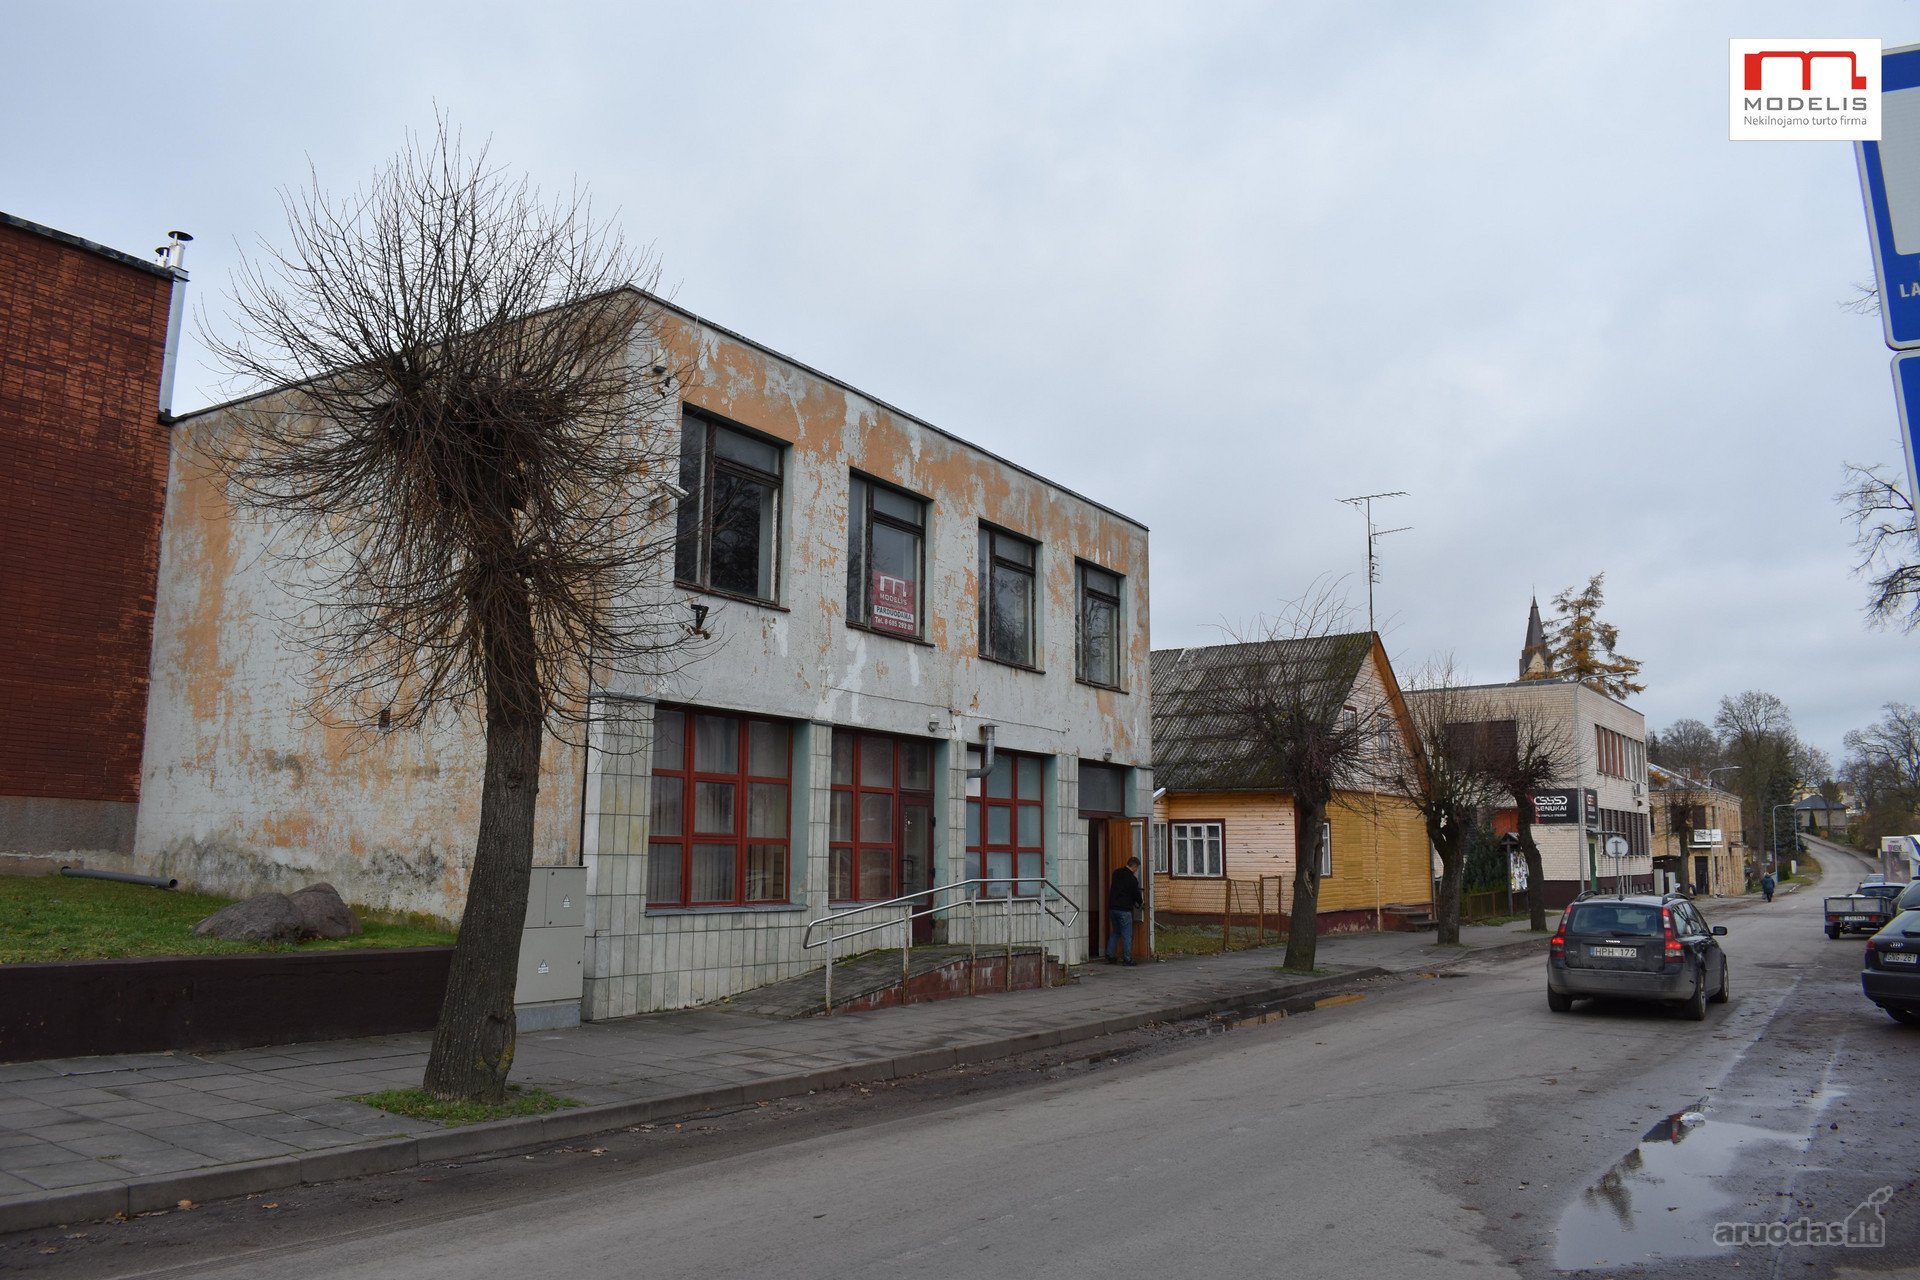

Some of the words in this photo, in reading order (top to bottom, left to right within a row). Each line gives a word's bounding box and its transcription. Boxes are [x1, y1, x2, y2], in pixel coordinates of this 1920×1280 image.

[880, 593, 908, 606] MODELIS
[876, 606, 912, 620] PARDUODAMA
[1595, 948, 1614, 956] HPH
[1619, 949, 1636, 957] 172
